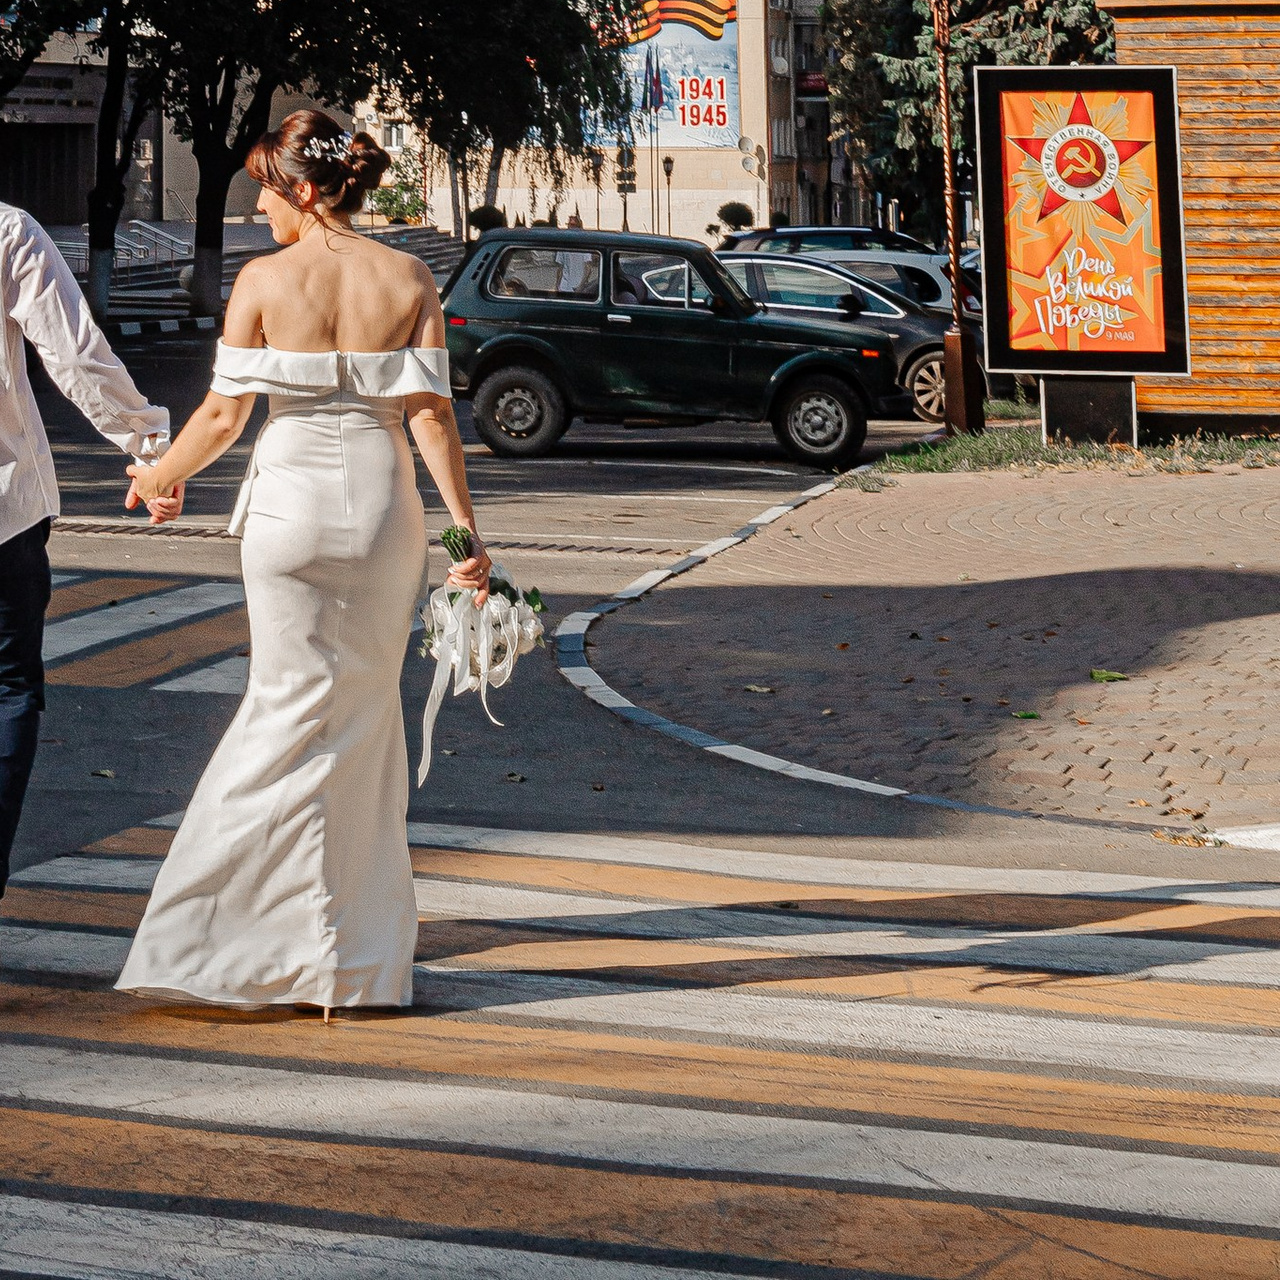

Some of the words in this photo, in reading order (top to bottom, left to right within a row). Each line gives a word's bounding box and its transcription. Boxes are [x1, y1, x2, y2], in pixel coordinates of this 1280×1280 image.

[678, 78, 725, 100] 1941
[678, 104, 727, 127] 1945
[1044, 127, 1110, 193] ОТЕЧЕСТВЕННАЯ
[1063, 247, 1115, 278] День
[1046, 265, 1134, 303] Великой
[1034, 295, 1125, 339] Победы
[1106, 331, 1112, 341] 9
[1114, 331, 1135, 341] МАЯ
